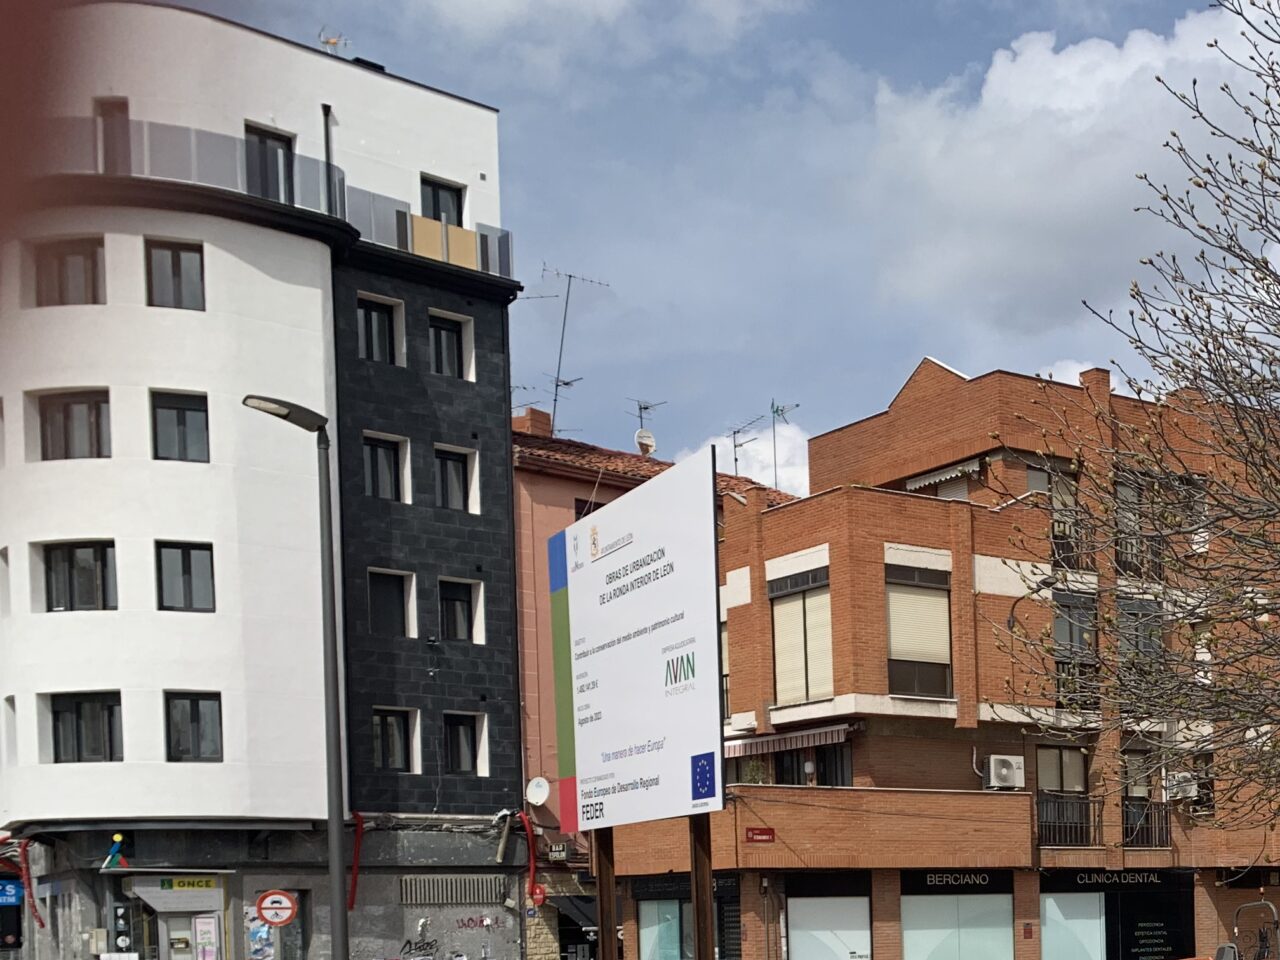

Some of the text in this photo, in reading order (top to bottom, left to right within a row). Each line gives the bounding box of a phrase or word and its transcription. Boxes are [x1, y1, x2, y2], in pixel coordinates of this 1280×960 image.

[599, 560, 675, 606] DE LA RONDA INTERIOR DE LEÓN
[605, 568, 622, 585] OBRAS
[622, 564, 629, 577] DE
[665, 651, 696, 687] AVAN
[665, 682, 697, 698] INTEGRAL
[611, 748, 628, 760] manera
[627, 745, 634, 756] de
[633, 743, 647, 755] hacer
[580, 774, 660, 800] Fondo Europeo de Desarrollo Regional
[581, 801, 605, 821] FEDER
[177, 879, 213, 889] ONCE
[926, 873, 989, 885] BERCIANO
[1076, 872, 1161, 885] CLINICA DENTAL
